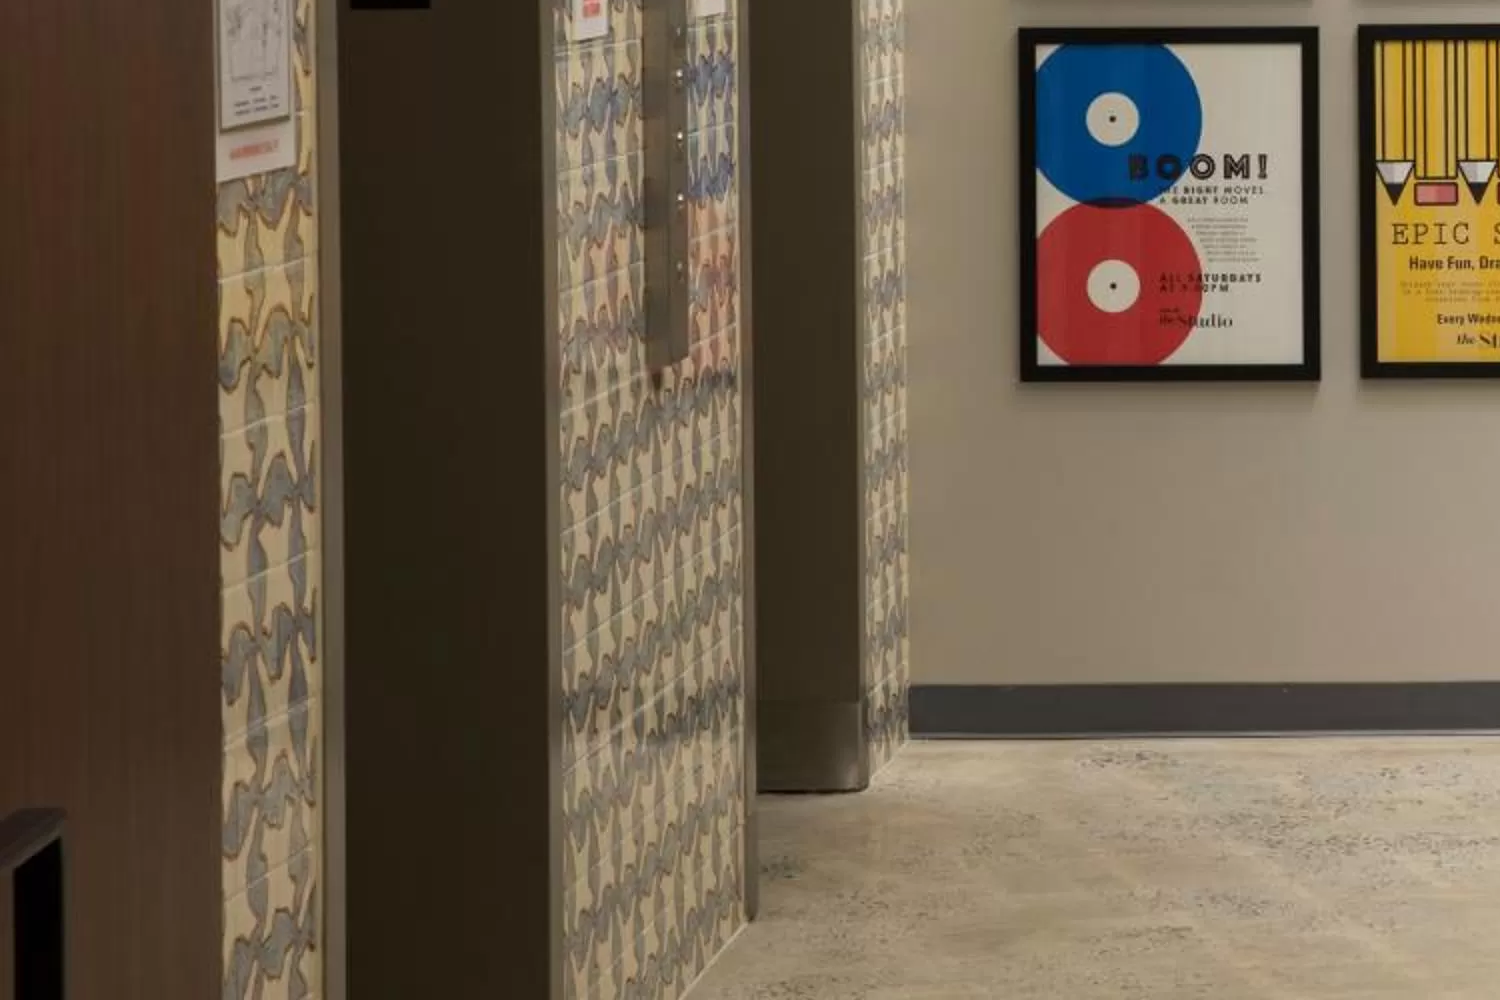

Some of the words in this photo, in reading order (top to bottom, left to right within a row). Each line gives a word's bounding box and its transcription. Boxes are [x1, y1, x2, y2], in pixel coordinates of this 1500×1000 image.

[1128, 153, 1268, 180] BOOM!
[1172, 196, 1208, 205] GREAT
[1213, 196, 1249, 205] ROOM
[1391, 222, 1470, 245] EPIC
[1409, 256, 1443, 270] Have
[1447, 256, 1475, 271] Fun,
[1188, 273, 1262, 283] SATURDAYS
[1436, 314, 1465, 325] Every
[1456, 332, 1475, 345] the
